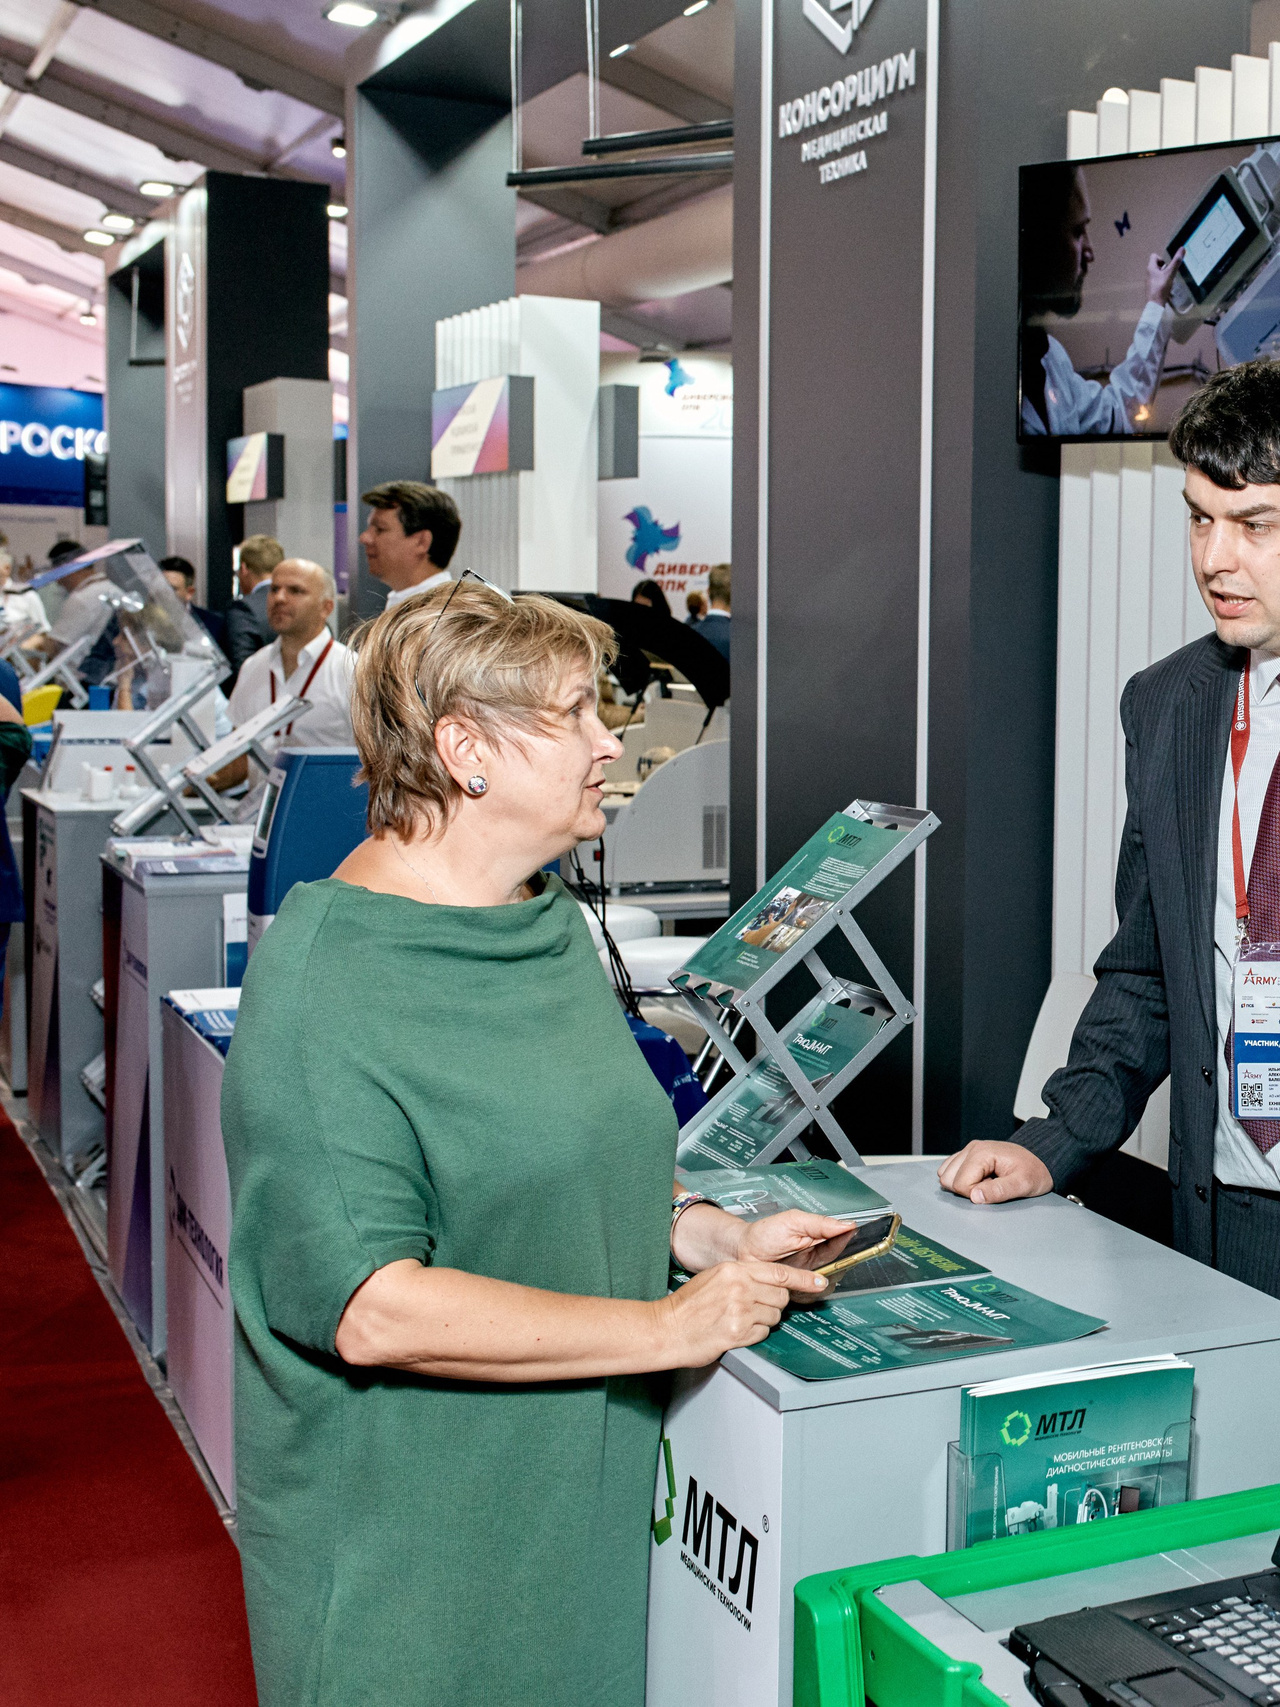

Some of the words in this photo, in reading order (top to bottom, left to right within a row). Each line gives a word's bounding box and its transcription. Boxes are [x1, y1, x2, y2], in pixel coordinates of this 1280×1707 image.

[779, 48, 916, 138] КОНСОРЦИУМ
[801, 111, 888, 163] МЕДИЦИНСКАЯ
[818, 150, 868, 184] ТЕХНИКА
[1243, 967, 1278, 986] ARMY
[1035, 1408, 1087, 1436] МТЛ
[1045, 1455, 1126, 1478] ДИАГНОСТИЧЕСКИЕ
[1127, 1448, 1173, 1463] АППАРАТЫ
[1053, 1446, 1106, 1463] МОБИЛЬНЫЕ
[1107, 1436, 1173, 1454] РЕНТГЕНОВСКИЕ
[681, 1475, 759, 1613] МТЛ
[680, 1550, 717, 1596] МЕДИЦИНСКИЕ
[717, 1588, 752, 1632] ТЕХНОЛОГИИ
